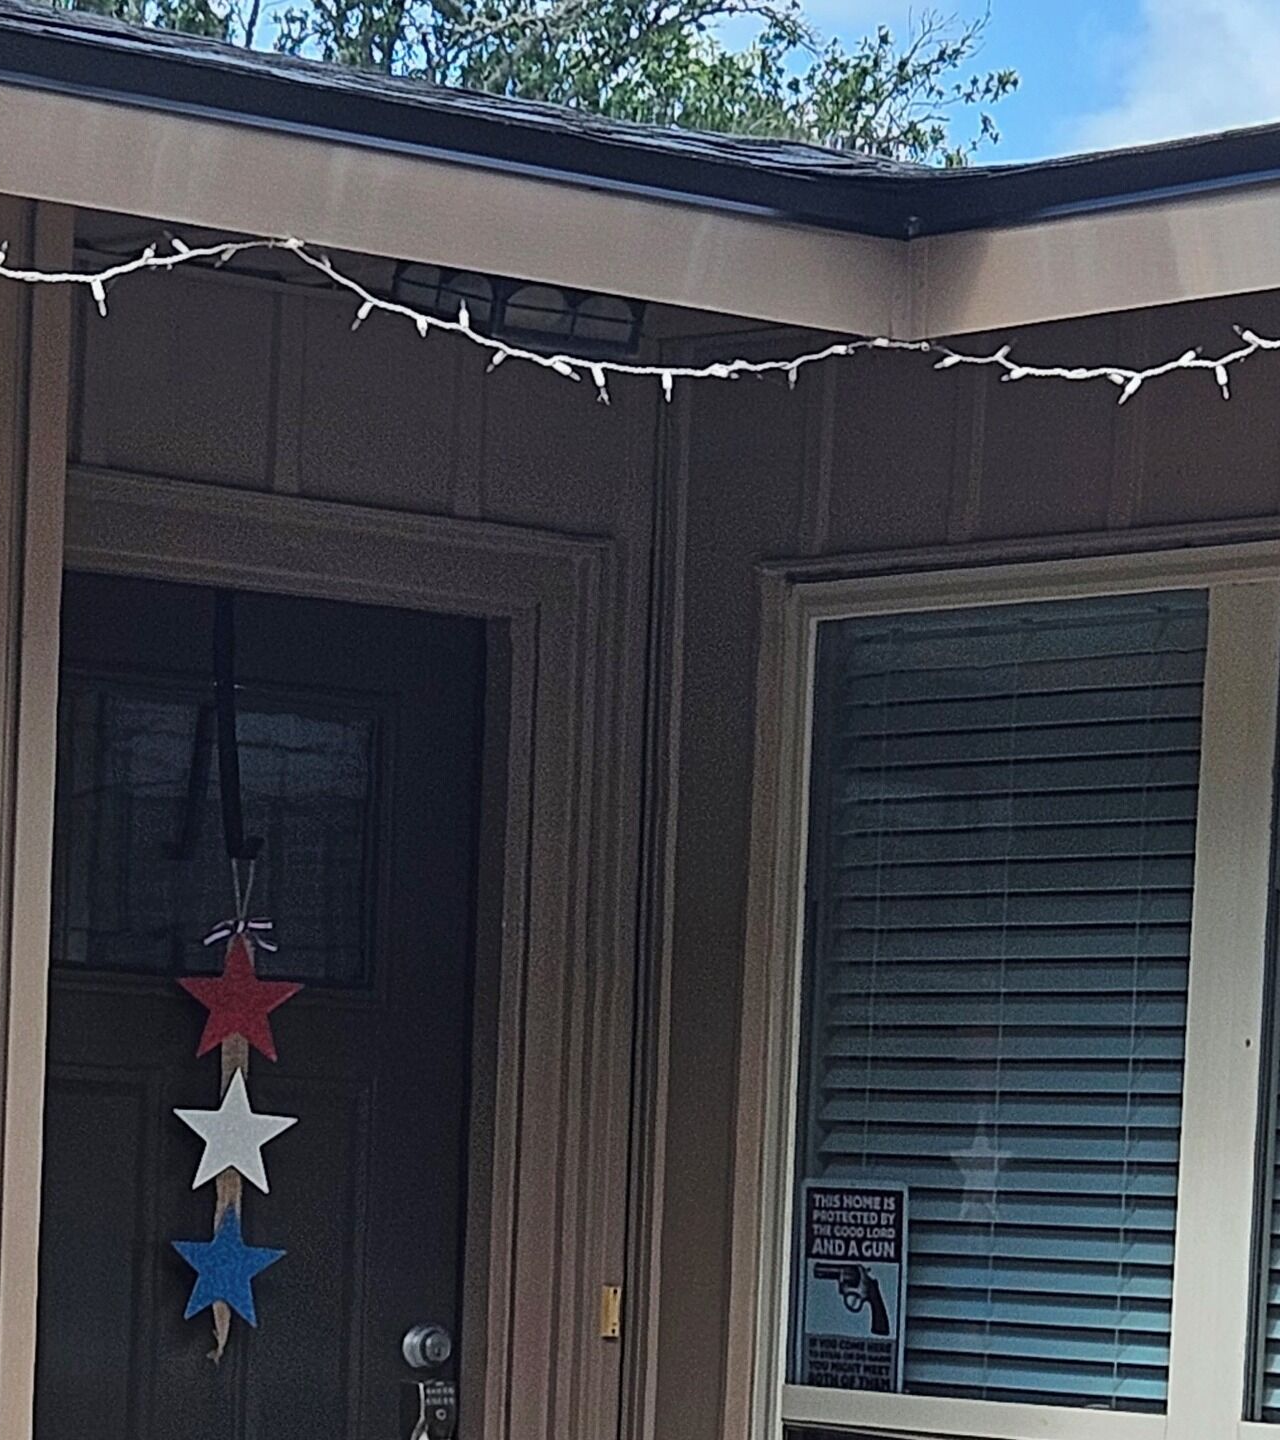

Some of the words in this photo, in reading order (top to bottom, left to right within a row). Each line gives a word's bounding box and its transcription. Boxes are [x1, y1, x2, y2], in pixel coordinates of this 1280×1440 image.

[813, 1193, 840, 1208] THIS
[842, 1194, 881, 1210] HOME
[883, 1196, 896, 1211] IS
[812, 1209, 878, 1225] PROTECTED
[880, 1212, 896, 1226] BY
[812, 1224, 832, 1237] THE
[834, 1225, 864, 1238] GOOD
[866, 1227, 896, 1239] LORD
[811, 1237, 845, 1256] AND
[847, 1239, 860, 1257] A
[861, 1240, 895, 1258] GUN
[839, 1340, 865, 1350] COME
[809, 1360, 829, 1371] YOU
[863, 1364, 890, 1376] MEET
[808, 1371, 839, 1387] BOTH
[840, 1373, 856, 1388] OF
